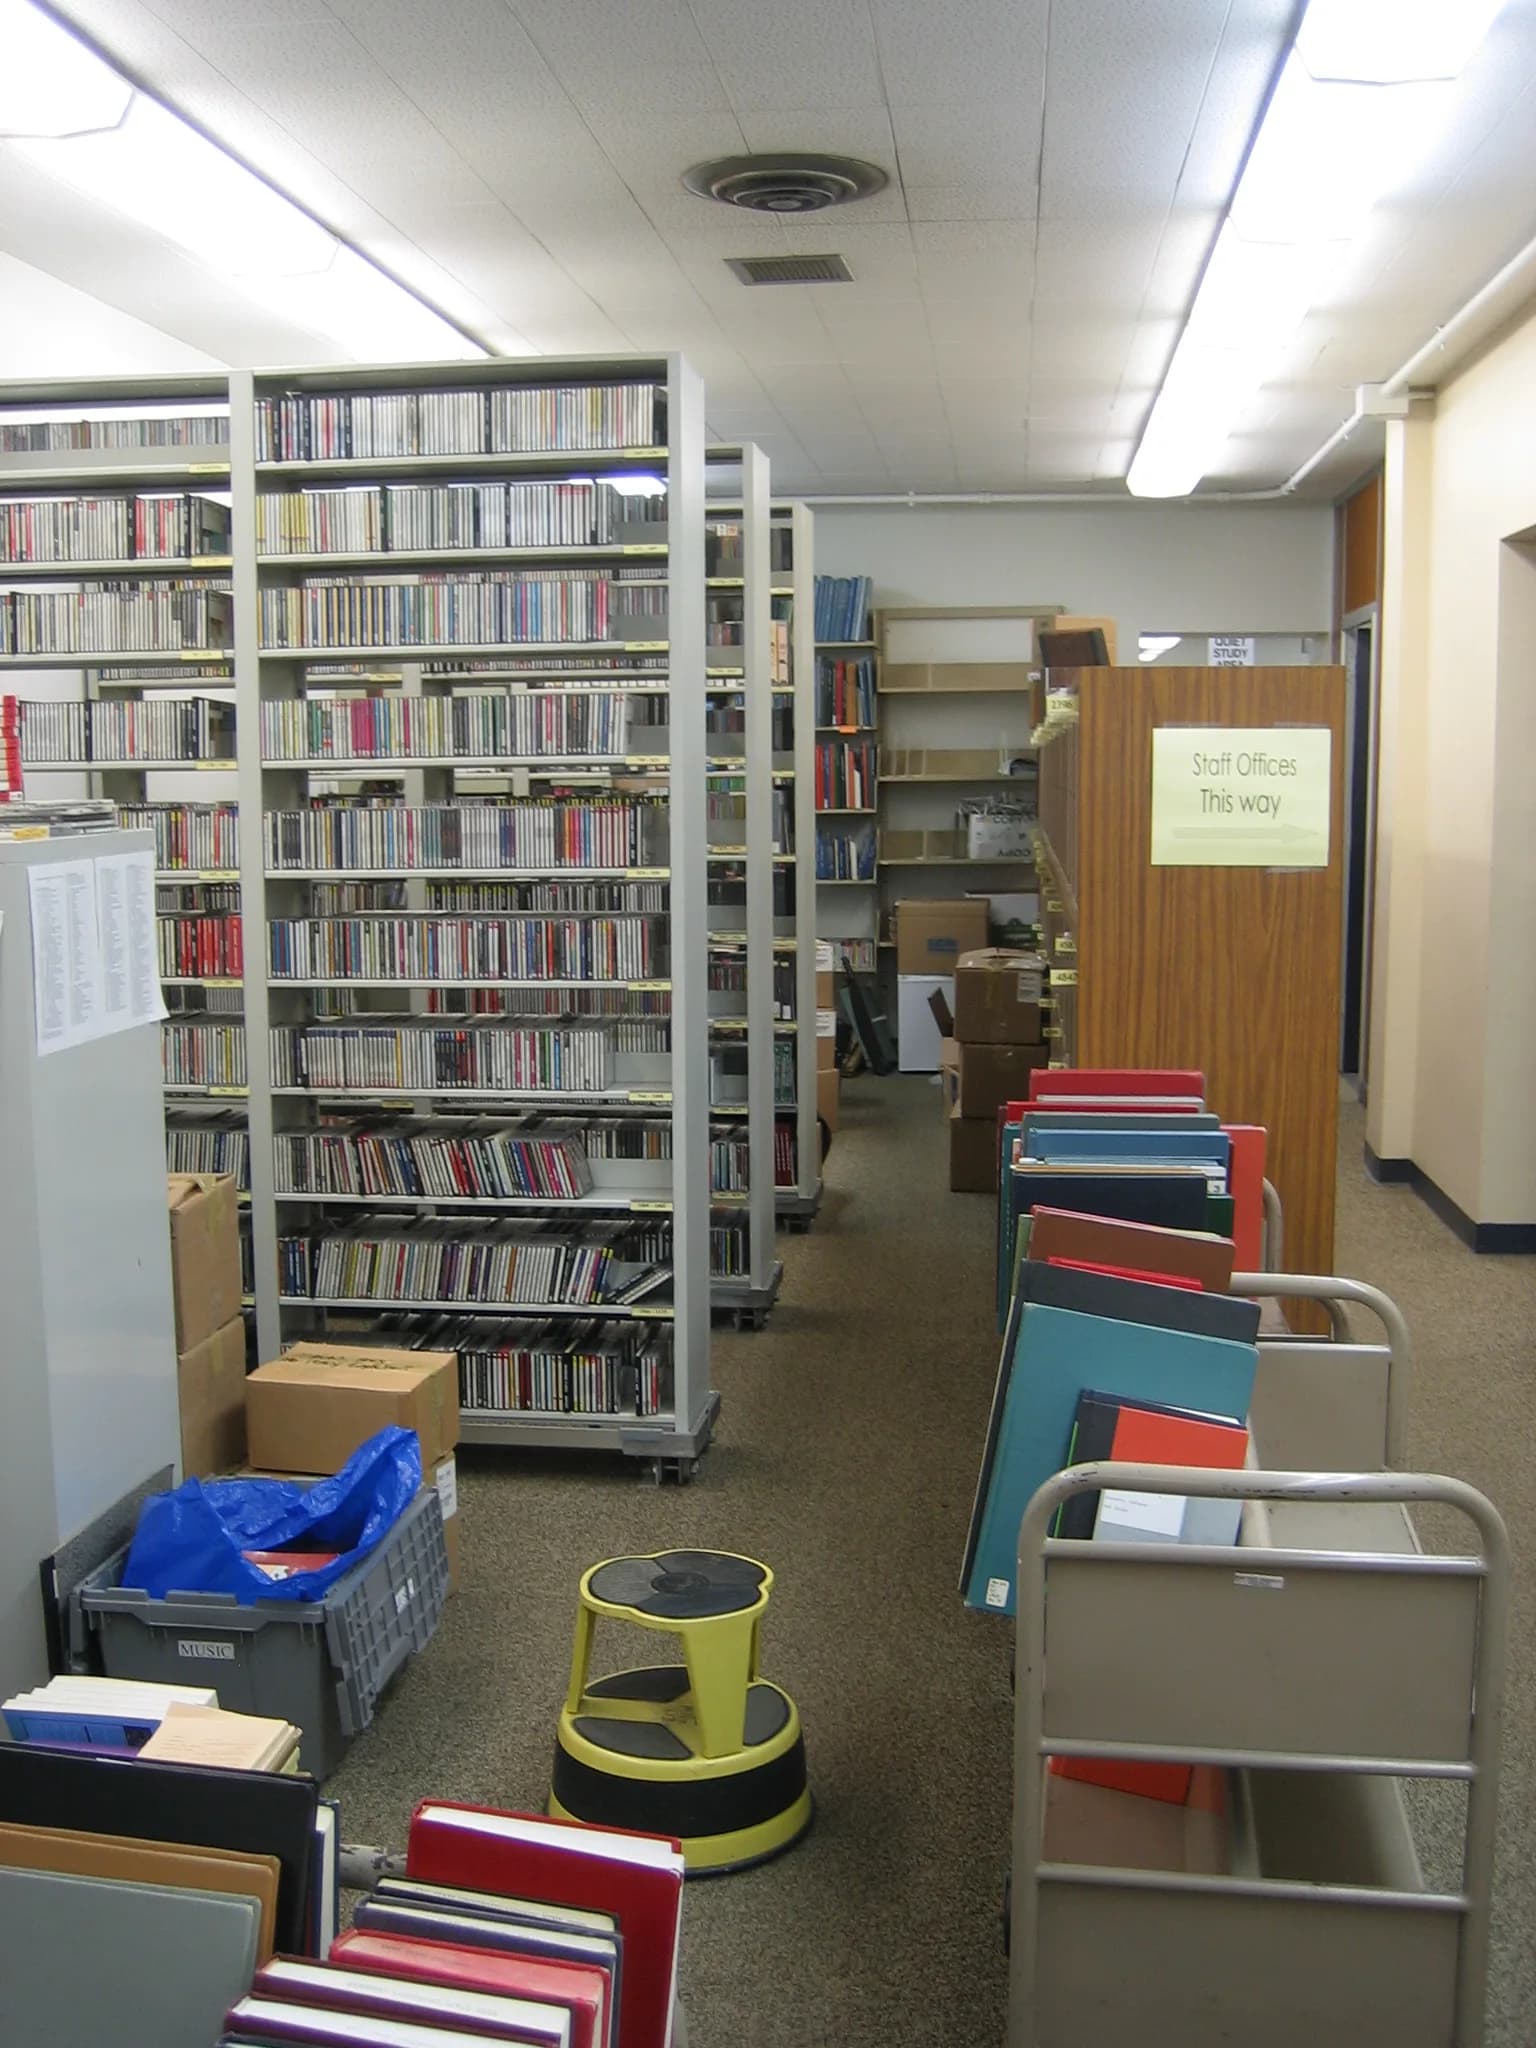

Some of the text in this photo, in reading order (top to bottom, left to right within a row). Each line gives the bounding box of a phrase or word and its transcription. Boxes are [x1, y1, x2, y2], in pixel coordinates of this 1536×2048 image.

[1213, 648, 1248, 658] STUDY
[1192, 752, 1297, 776] Staff Offices
[1200, 788, 1281, 819] This way
[180, 1643, 231, 1658] MUSIC
